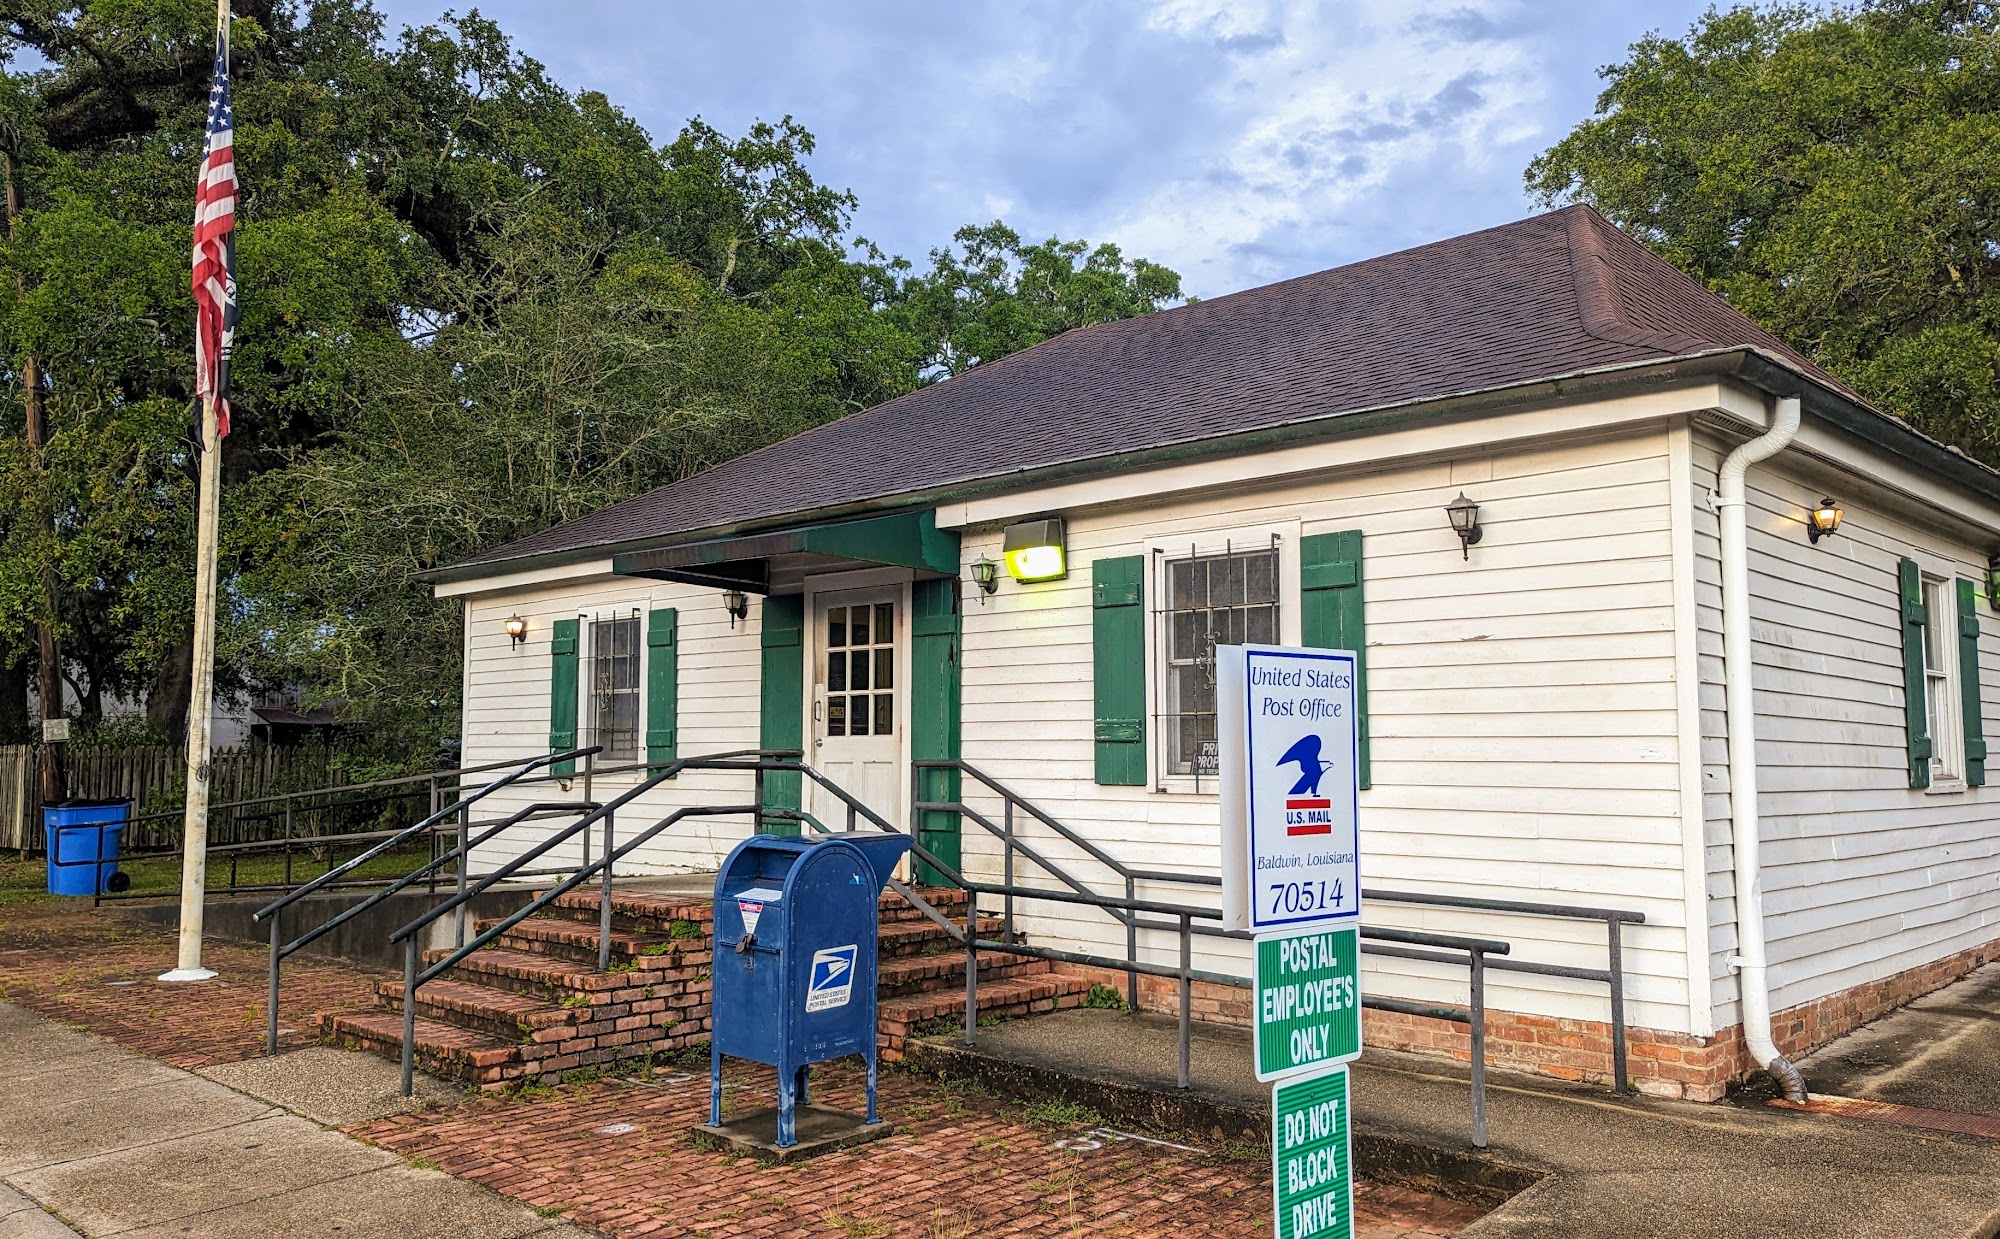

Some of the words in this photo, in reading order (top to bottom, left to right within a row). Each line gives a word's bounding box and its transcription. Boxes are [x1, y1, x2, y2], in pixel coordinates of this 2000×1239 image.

[1252, 666, 1302, 687] United
[1305, 669, 1350, 689] States
[1262, 697, 1295, 716] Post
[1299, 698, 1342, 721] Office
[1286, 811, 1306, 825] U.S.
[1308, 810, 1332, 824] MAIL
[1257, 854, 1304, 870] Baldwin,
[1306, 851, 1354, 867] Louisiana
[1269, 876, 1344, 914] 70514
[1280, 934, 1337, 975] POSTAL
[809, 1000, 827, 1008] POSTAL
[828, 996, 847, 1004] SERVICE
[810, 993, 829, 1001] UNITED
[1263, 974, 1354, 1024] EMPLOYEE'S
[1290, 1022, 1330, 1065] ONLY
[1284, 1109, 1306, 1149] DO
[1309, 1099, 1338, 1141] NOT
[1288, 1144, 1338, 1195] BLOCK
[1292, 1191, 1337, 1239] DRIVE
